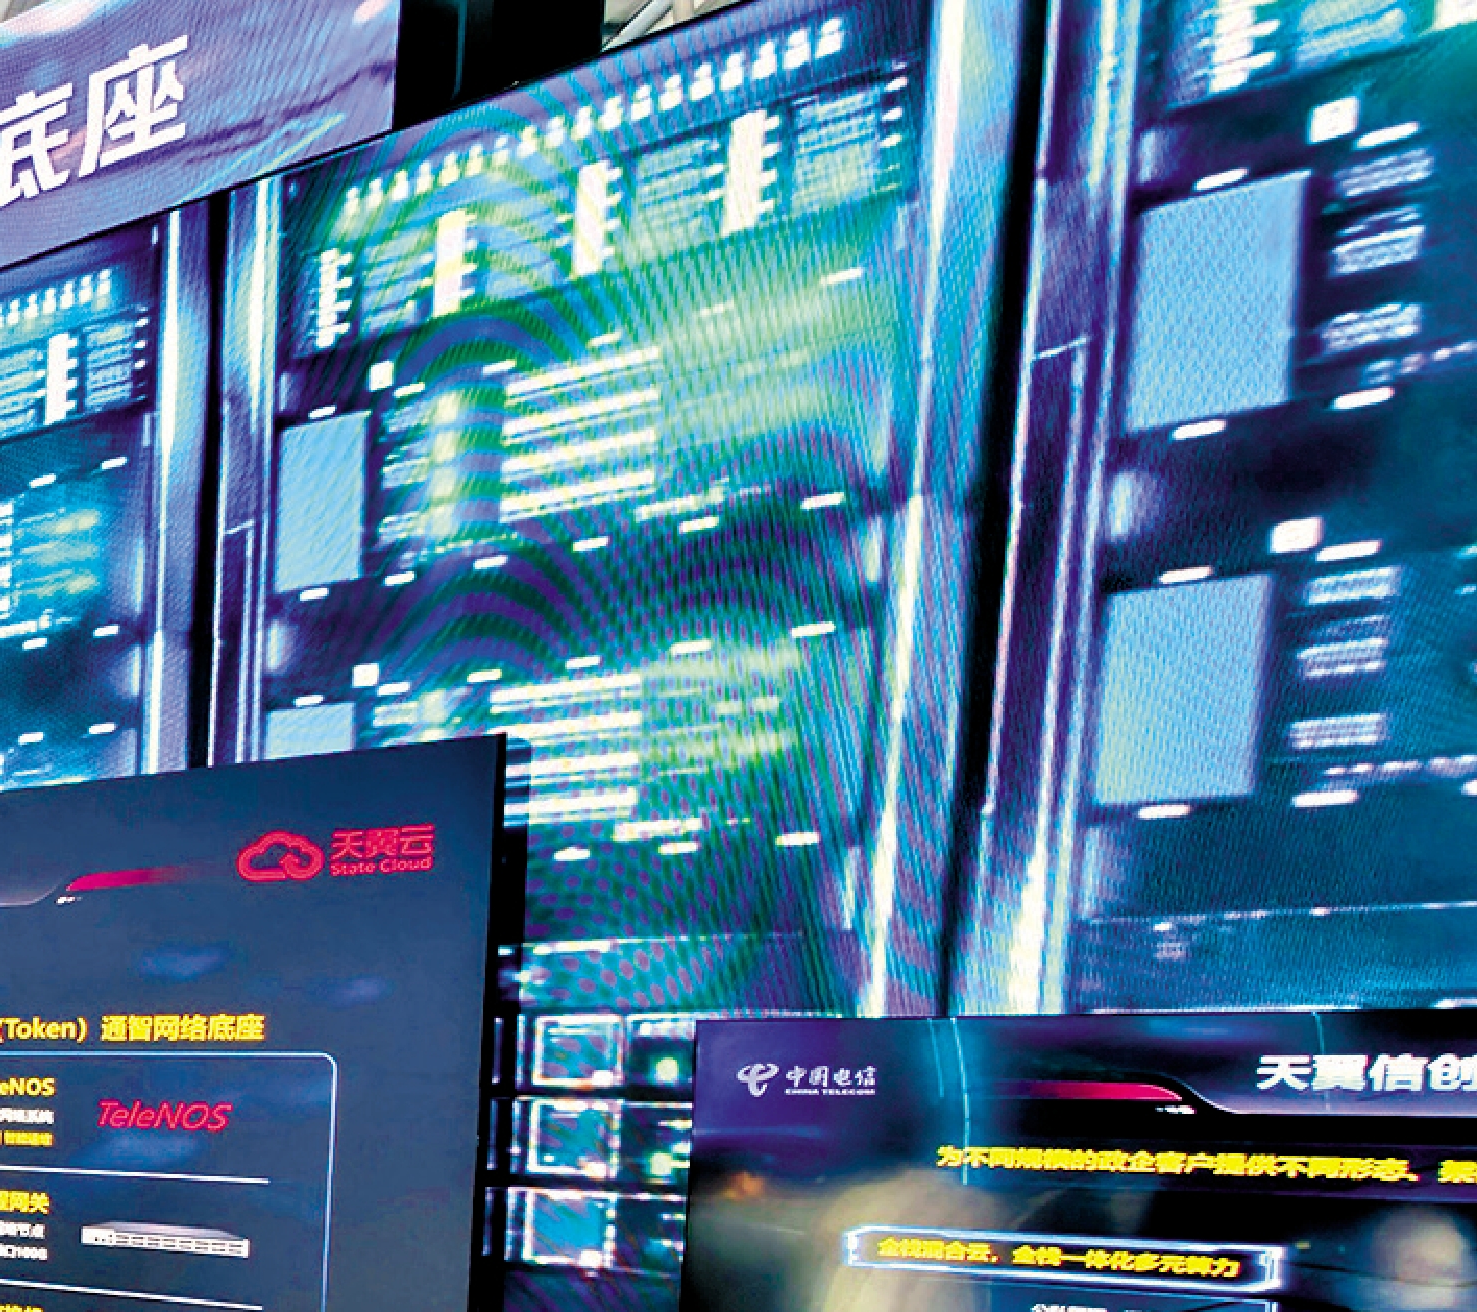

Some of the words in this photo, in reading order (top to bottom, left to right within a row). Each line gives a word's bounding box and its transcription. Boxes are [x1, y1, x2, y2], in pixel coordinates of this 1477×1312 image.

[330, 823, 435, 863] 天翼云
[329, 861, 378, 877] State
[378, 853, 434, 874] Cloud
[785, 1066, 877, 1089] 中国电信
[1256, 1053, 1477, 1092] 天翼信创
[97, 1099, 234, 1132] TeleNOS
